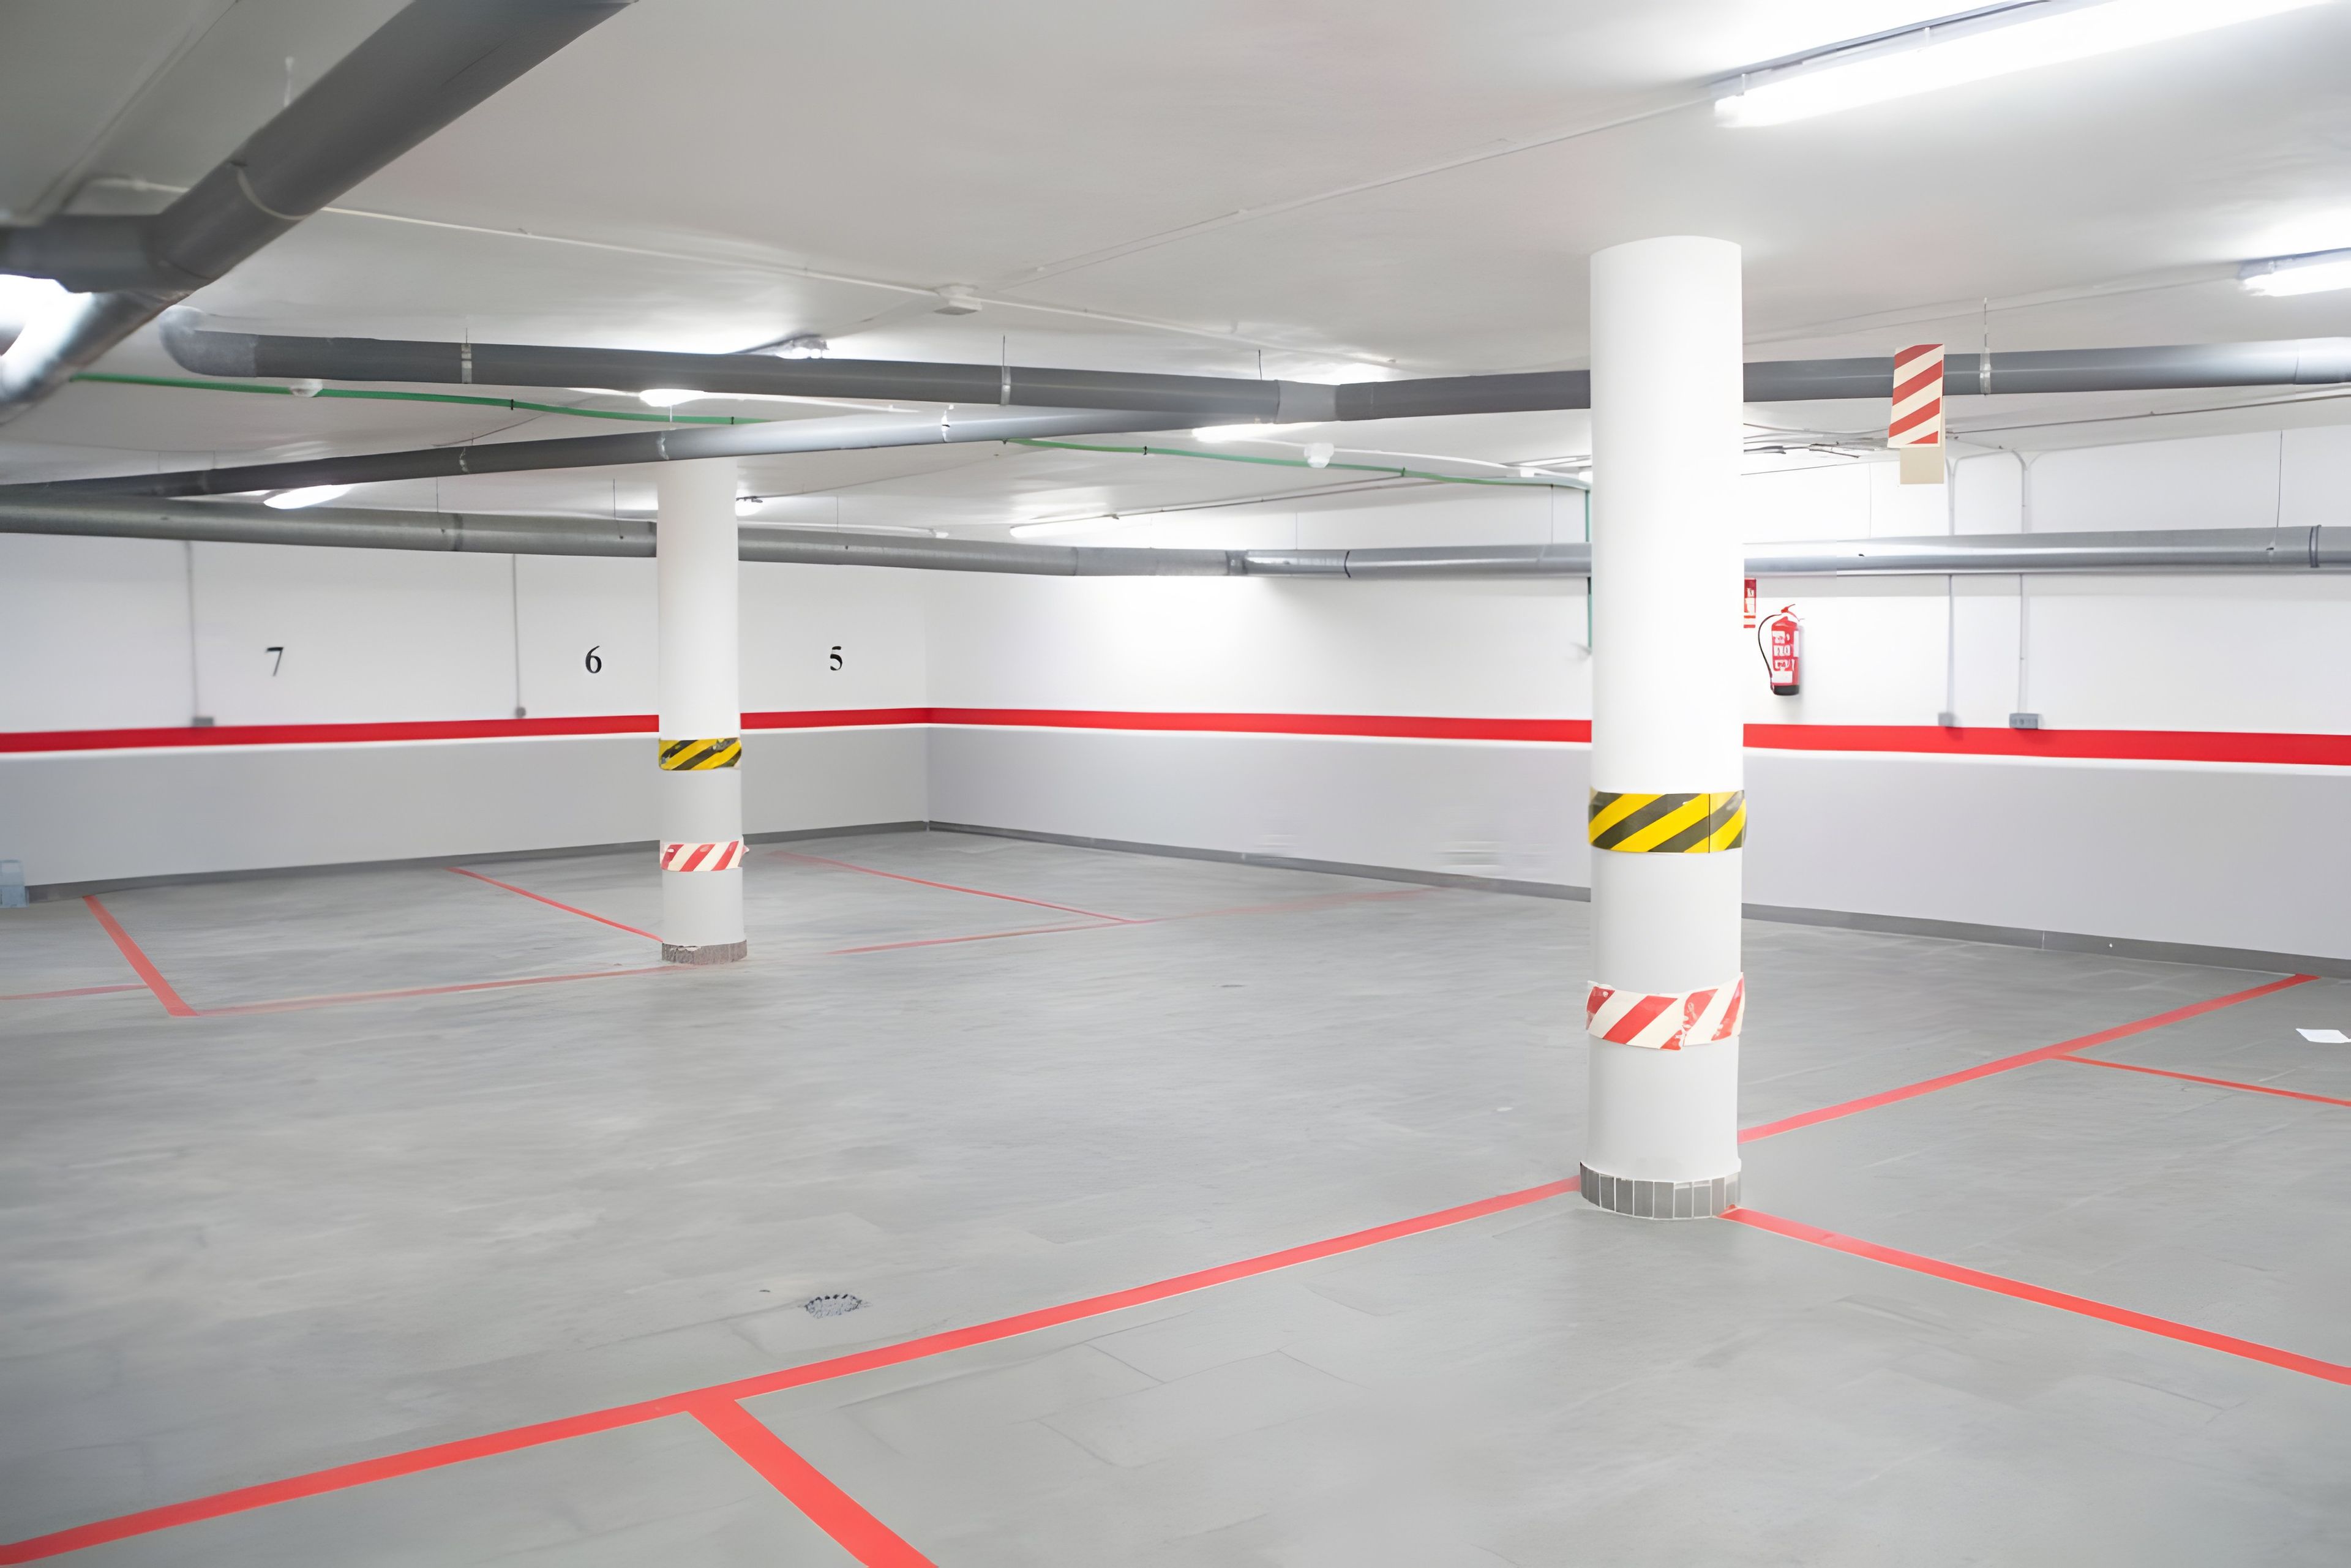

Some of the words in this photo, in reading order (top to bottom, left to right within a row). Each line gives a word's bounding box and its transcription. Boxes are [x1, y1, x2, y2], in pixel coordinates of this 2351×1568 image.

[266, 647, 284, 676] 7
[585, 645, 602, 674] 6
[830, 646, 843, 671] 5
